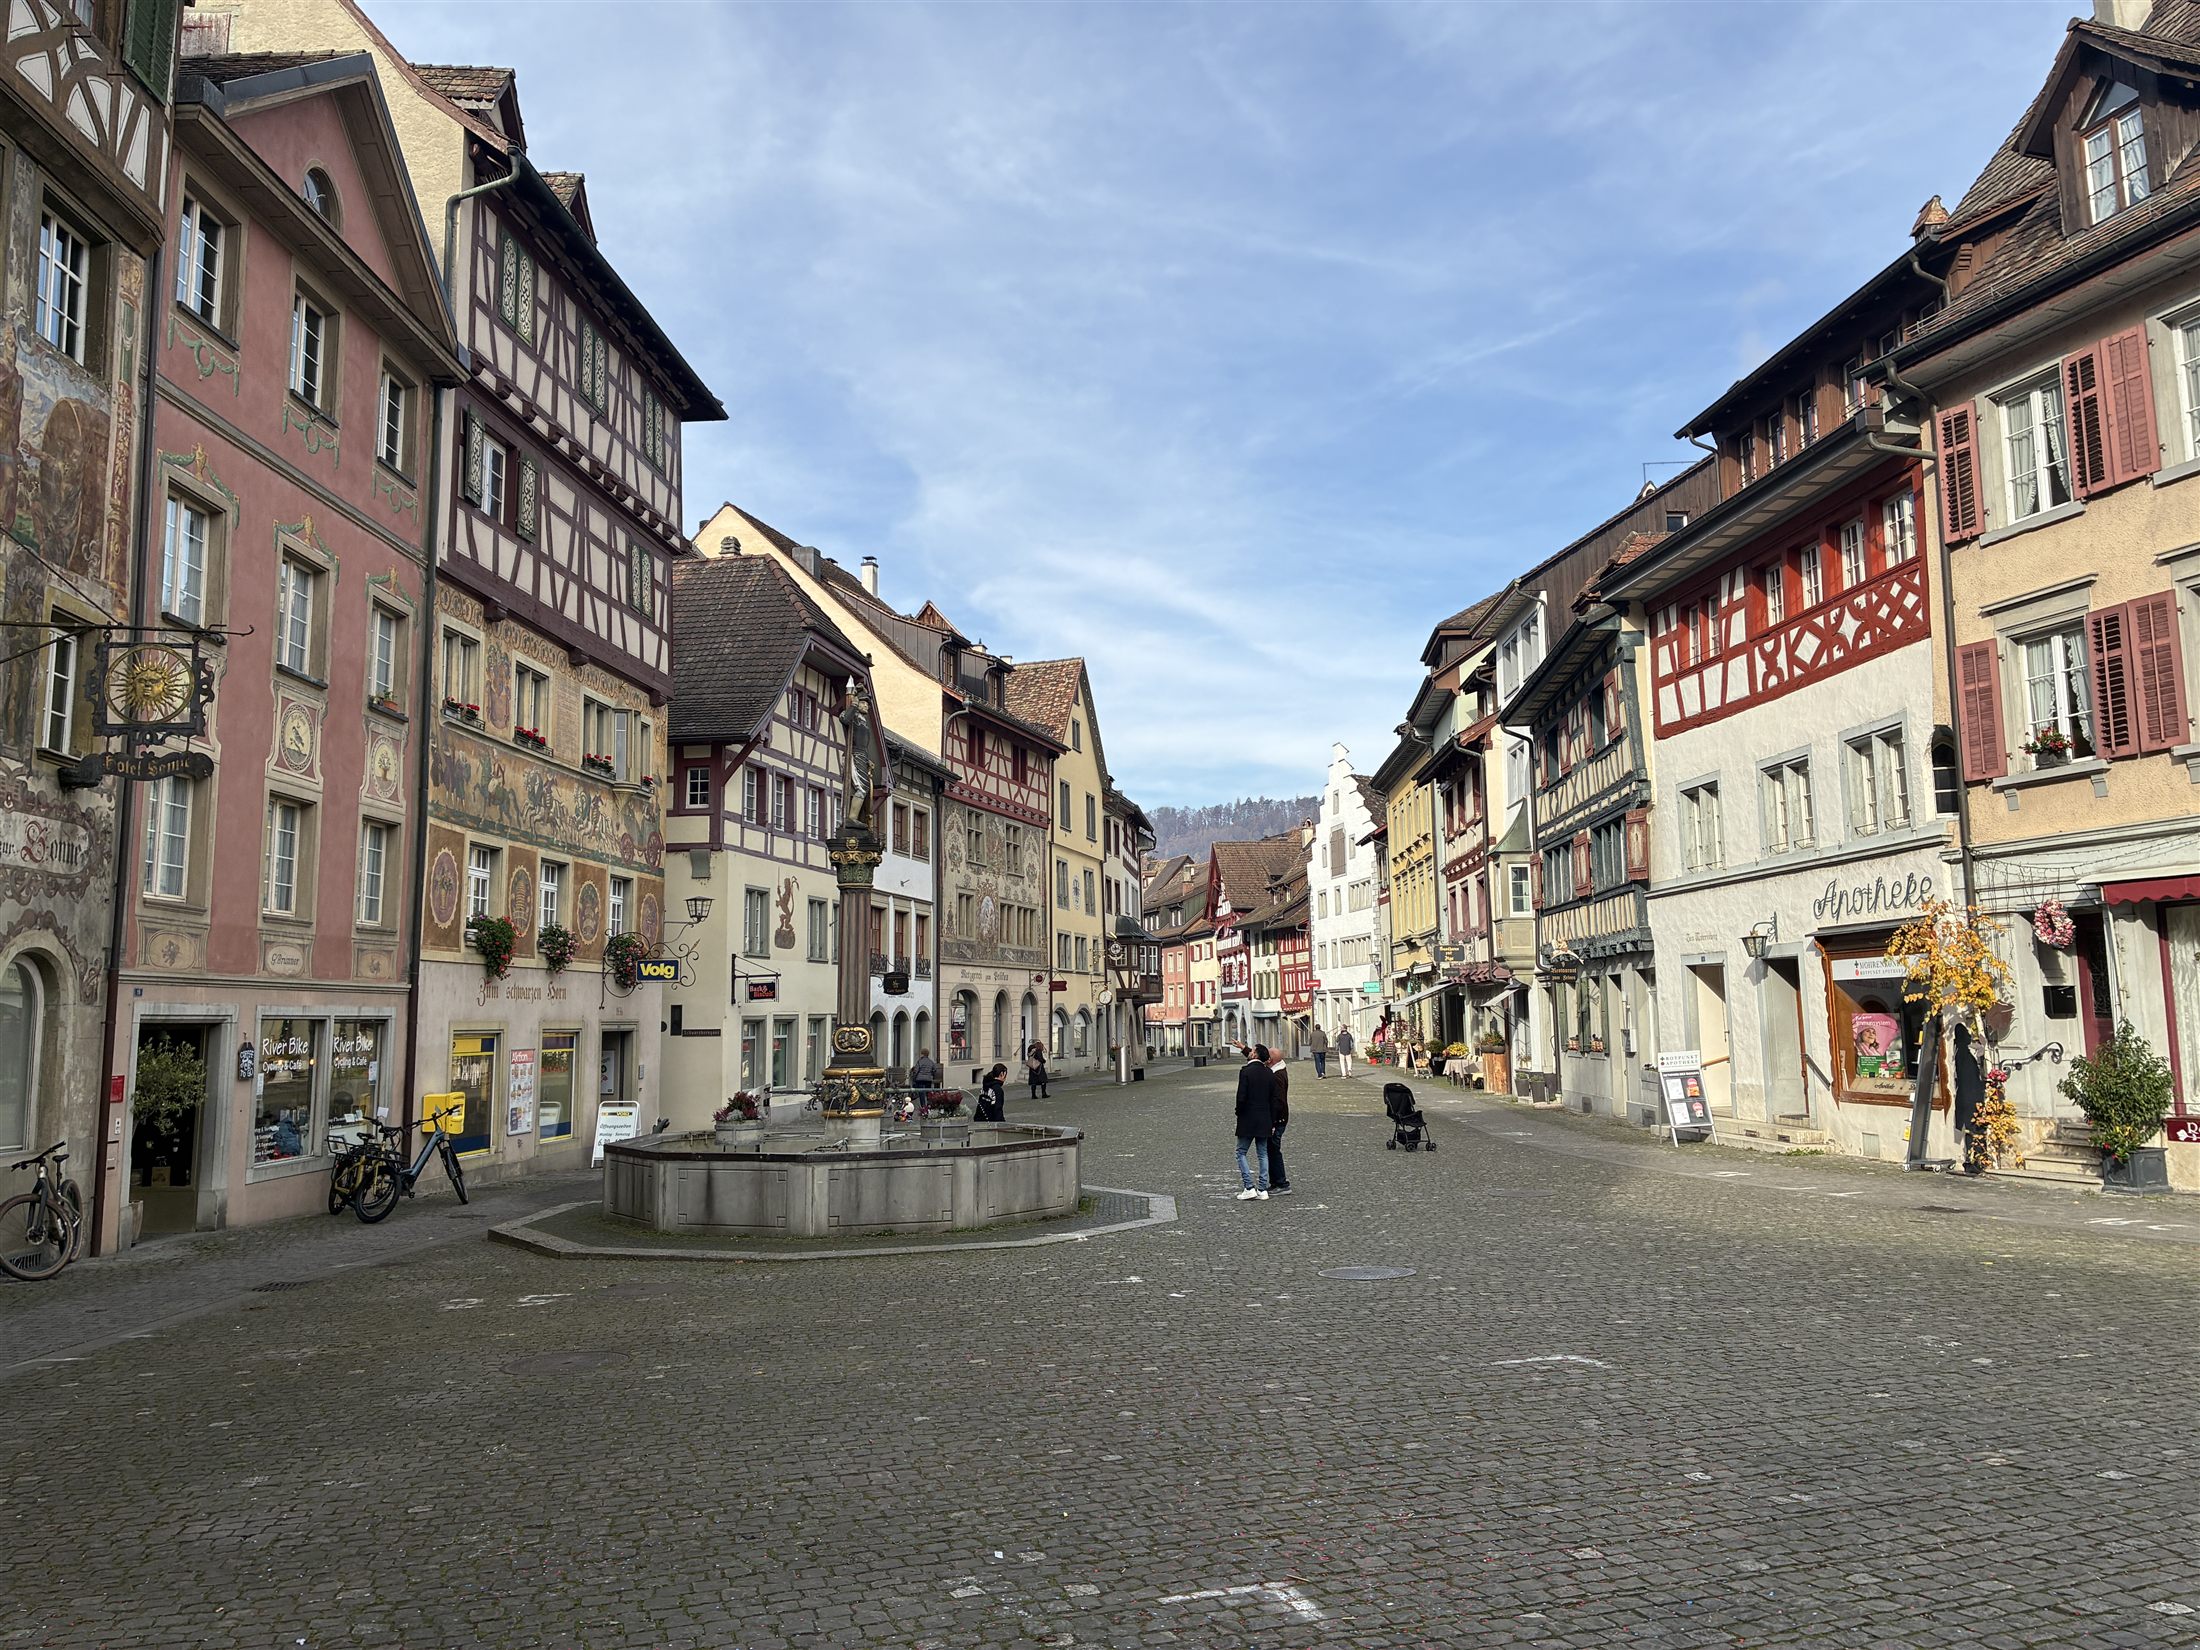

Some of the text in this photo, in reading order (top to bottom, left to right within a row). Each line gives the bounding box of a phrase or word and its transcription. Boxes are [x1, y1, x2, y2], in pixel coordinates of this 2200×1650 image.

[104, 755, 142, 776] Hotel
[1813, 872, 1935, 924] Apotheke
[640, 963, 675, 979] Volg
[506, 982, 541, 1004] schwarzen
[262, 1037, 308, 1055] River Bike
[333, 1034, 373, 1053] River Bike
[2187, 1122, 2200, 1135] R
